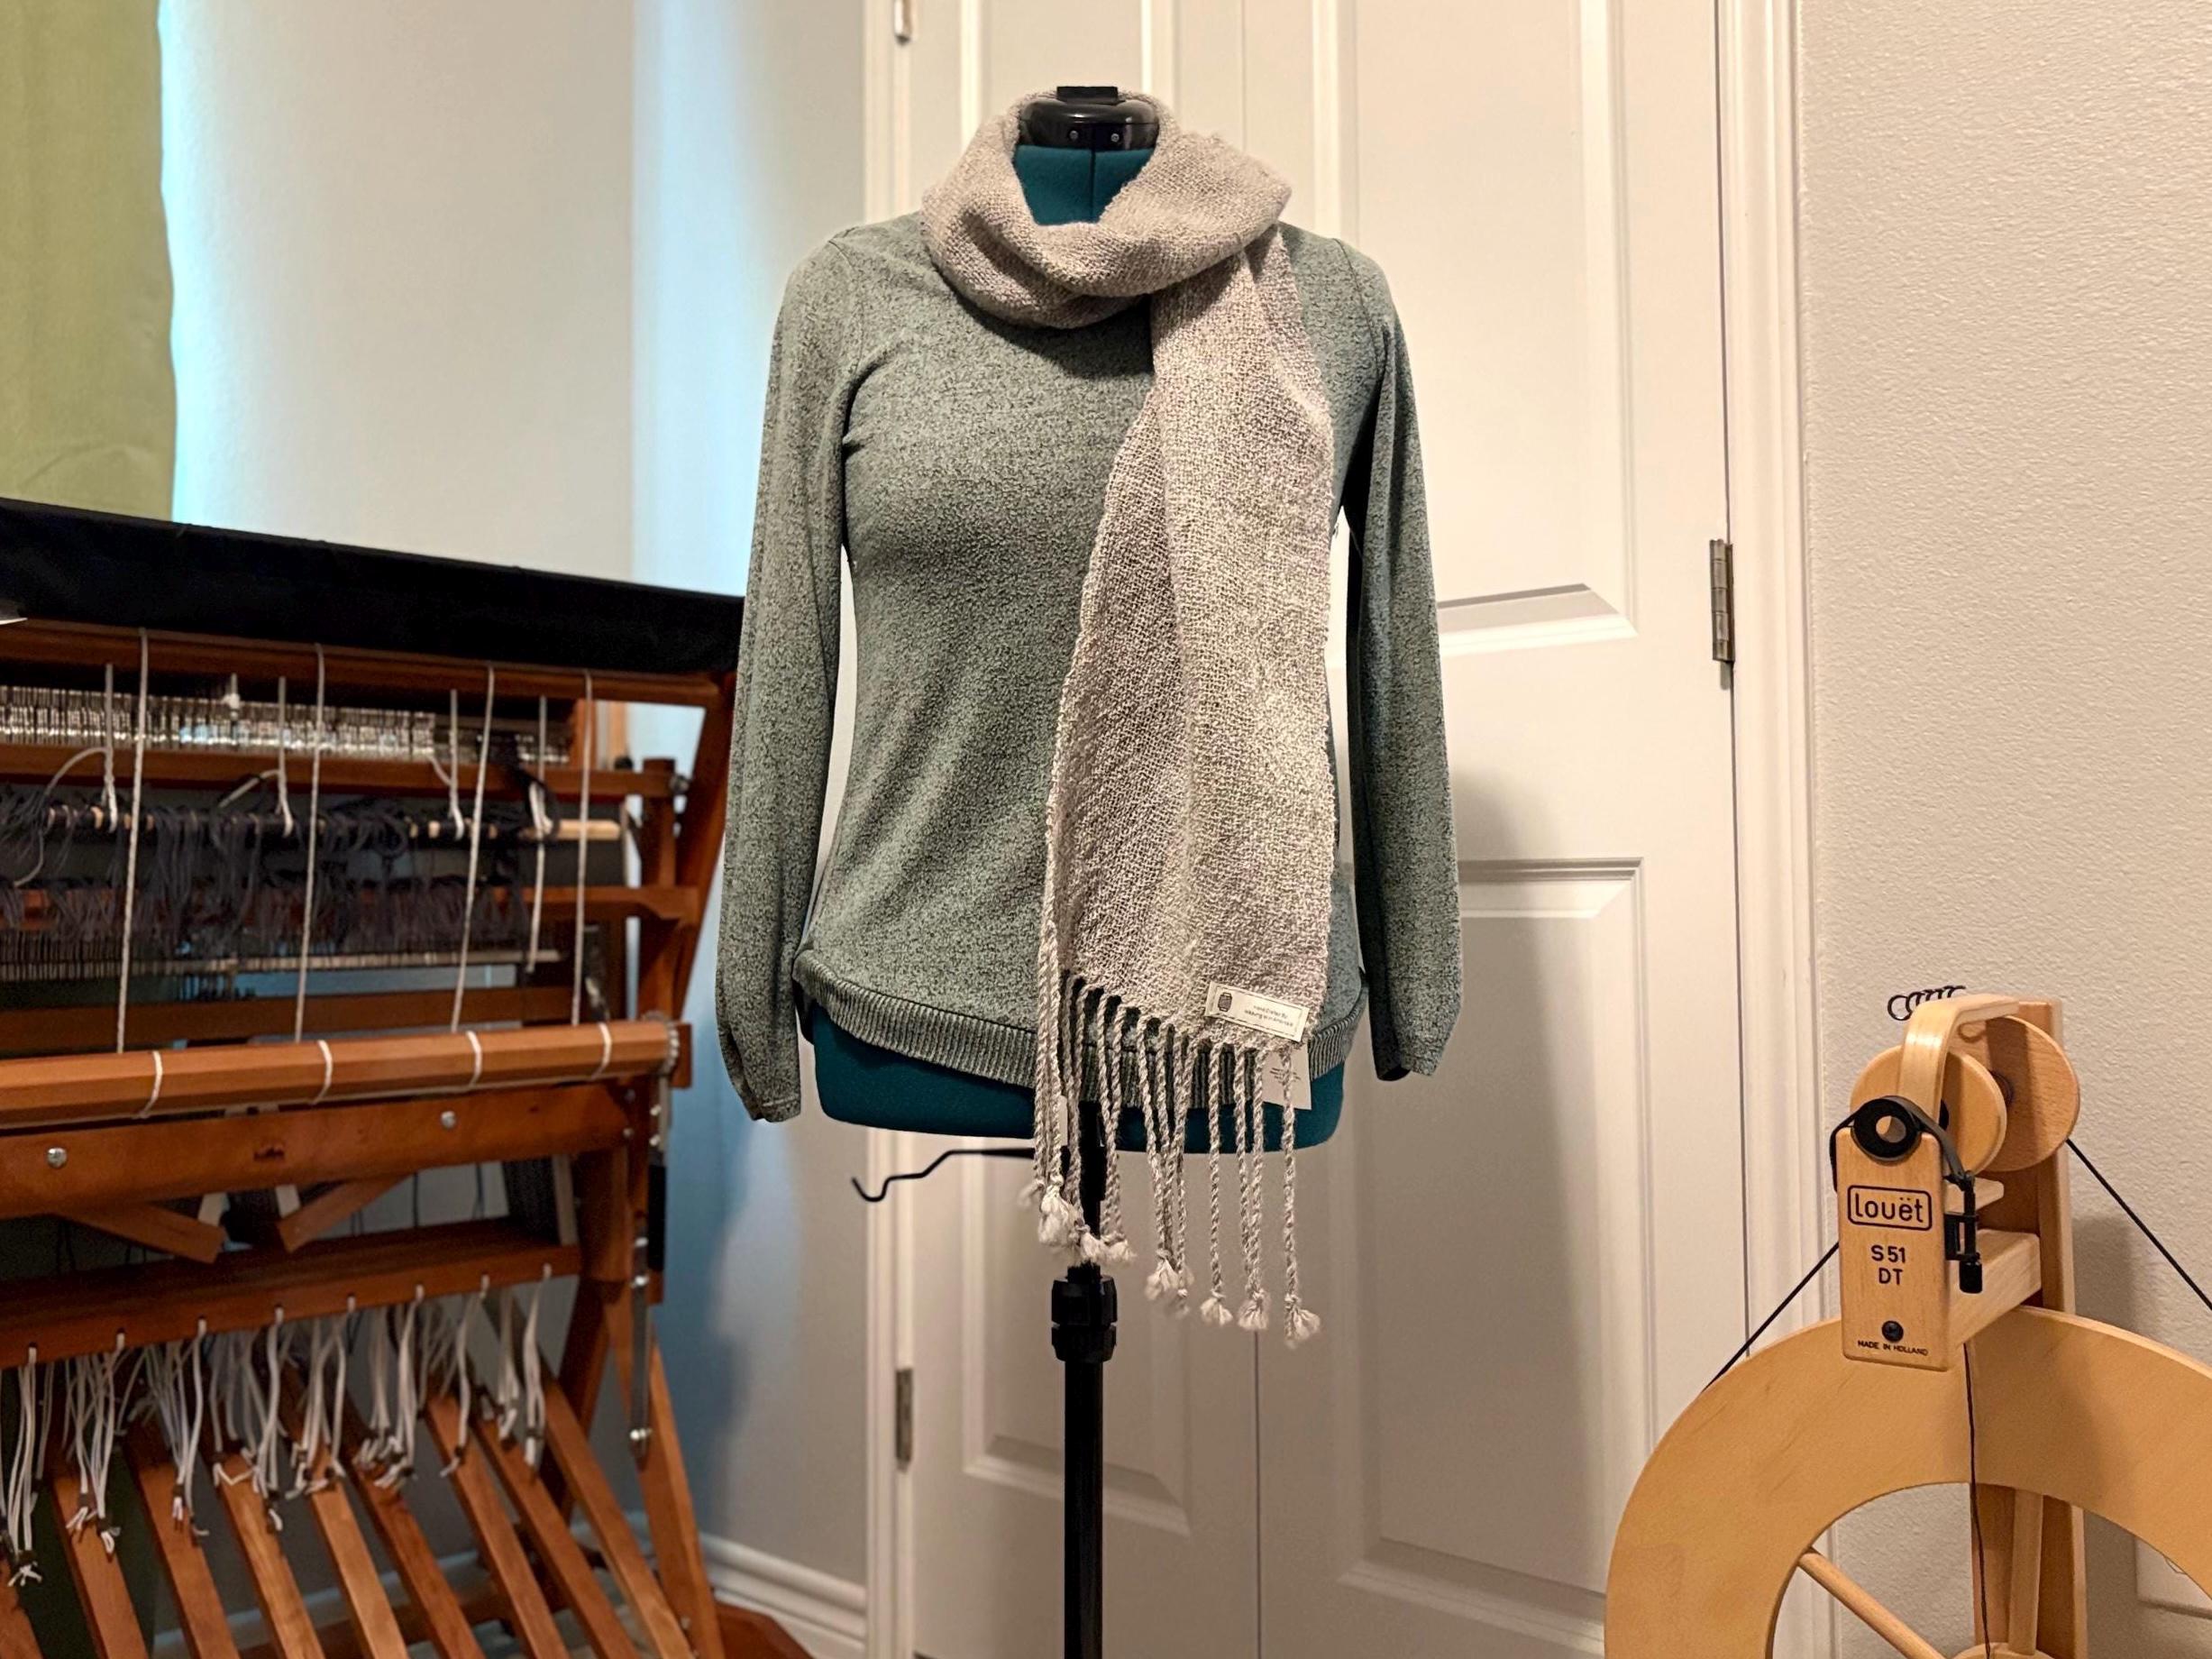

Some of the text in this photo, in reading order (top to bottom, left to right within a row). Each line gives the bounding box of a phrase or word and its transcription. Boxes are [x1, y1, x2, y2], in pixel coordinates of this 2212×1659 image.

[1878, 1267, 1903, 1285] DT
[1858, 1340, 1879, 1350] MADE
[1894, 1344, 1929, 1356] HOLLAND
